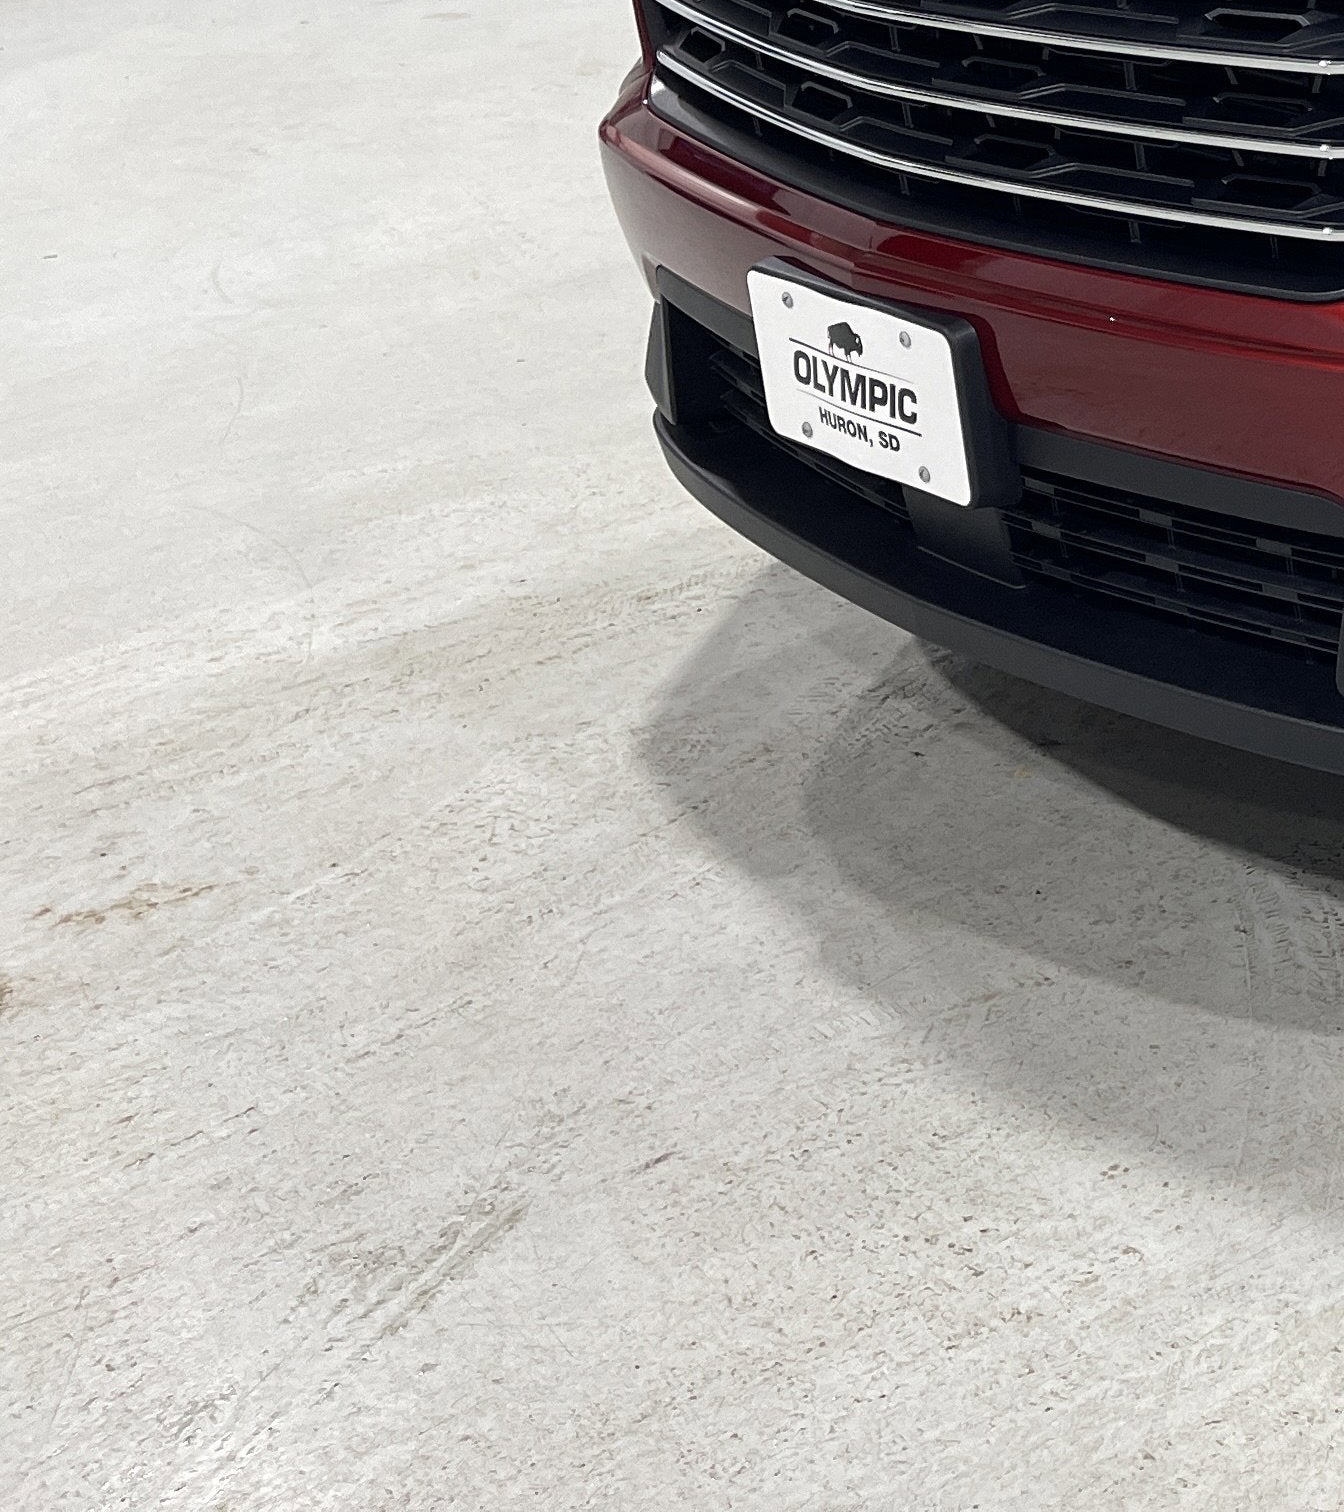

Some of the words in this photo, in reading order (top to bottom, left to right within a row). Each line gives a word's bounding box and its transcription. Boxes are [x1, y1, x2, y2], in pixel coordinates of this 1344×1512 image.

[793, 349, 918, 425] OLYMPIC
[818, 406, 874, 447] HURON,
[878, 430, 901, 452] SD
